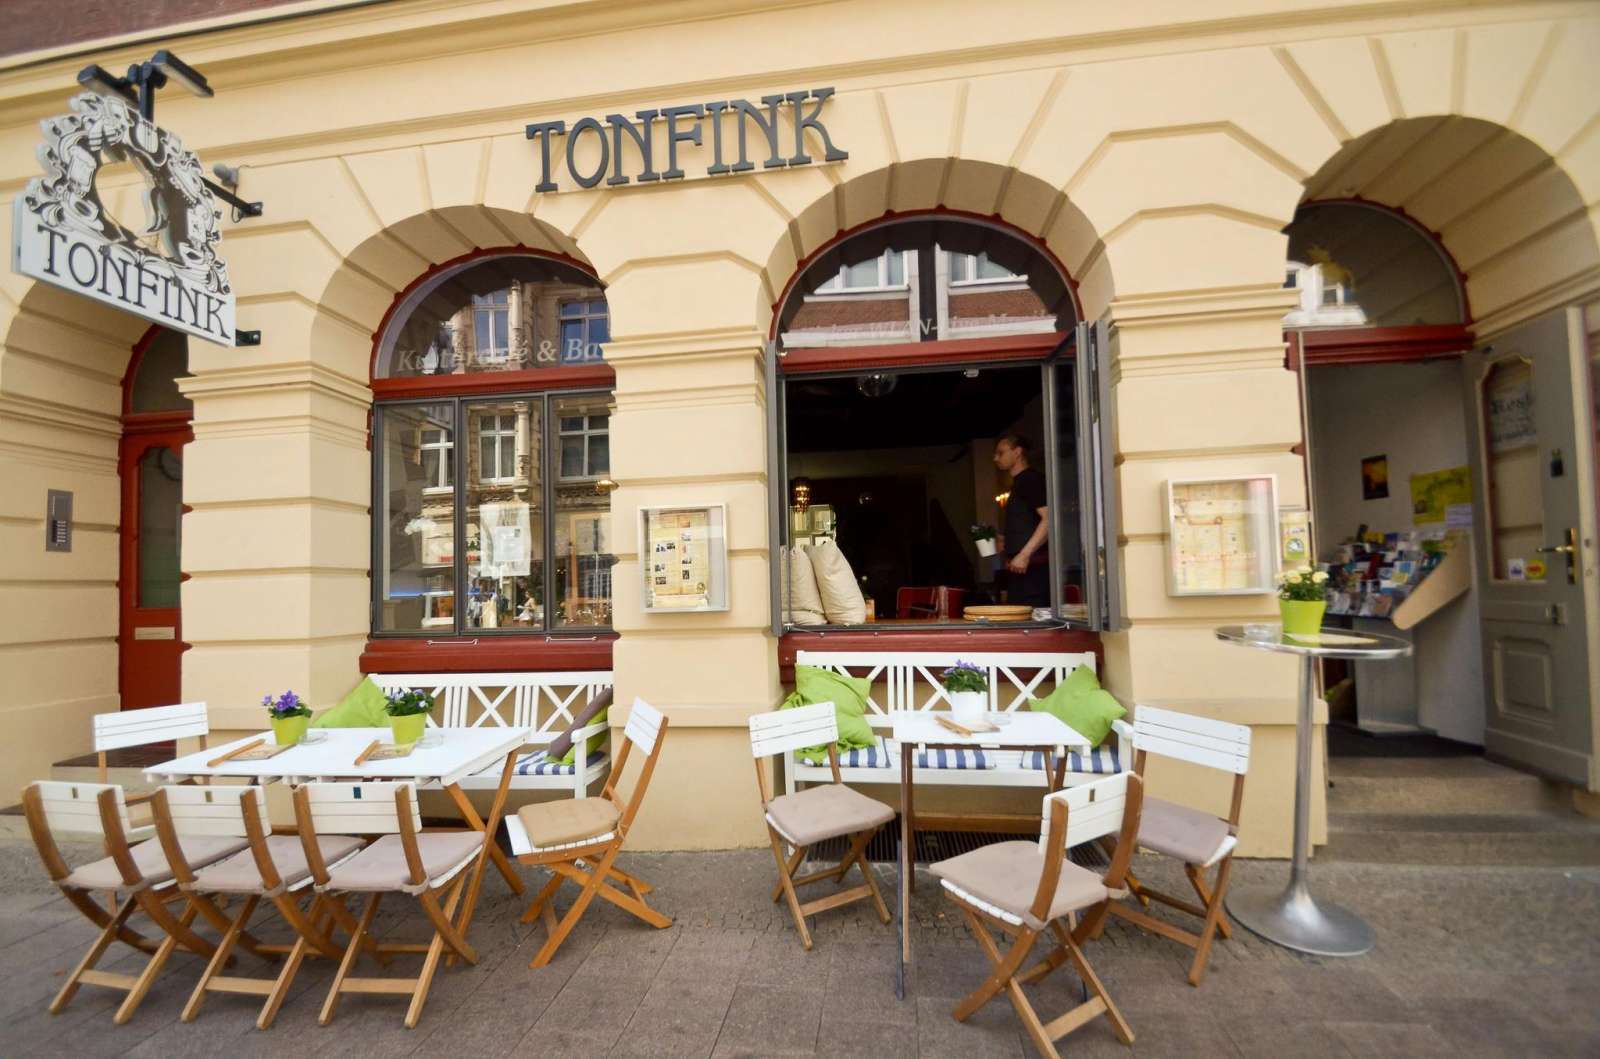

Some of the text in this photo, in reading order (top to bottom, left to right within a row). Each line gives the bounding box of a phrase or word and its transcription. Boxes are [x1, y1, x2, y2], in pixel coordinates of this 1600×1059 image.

[525, 87, 849, 193] TONFINK
[37, 224, 231, 340] TONFINK
[536, 339, 557, 362] &
[563, 337, 605, 361] Ba
